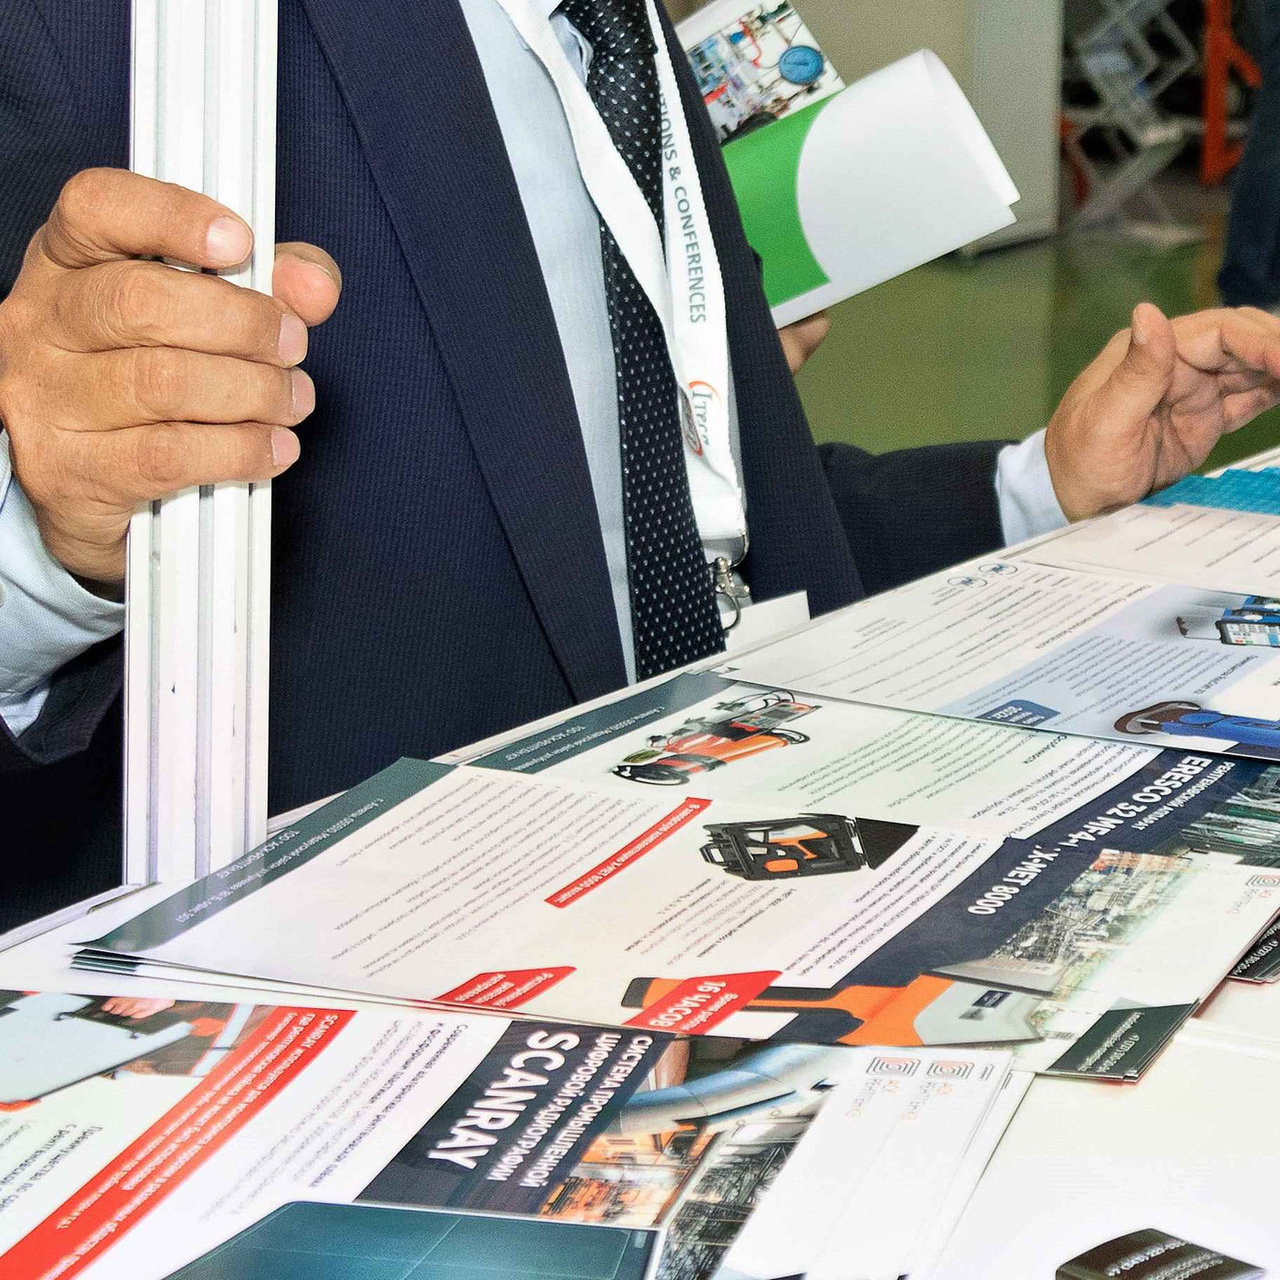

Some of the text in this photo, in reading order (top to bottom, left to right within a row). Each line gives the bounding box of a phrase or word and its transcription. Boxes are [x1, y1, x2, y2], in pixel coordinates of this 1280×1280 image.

[668, 166, 682, 182] &
[673, 185, 707, 324] CONFERENCES
[1128, 755, 1214, 804] ERESCO
[1129, 761, 1237, 830] РЕНТГЕНОВСКИЙ АППАРАТ
[1105, 801, 1148, 819] 32
[964, 849, 1059, 915] X-MET 8000
[296, 1014, 341, 1048] SCANRAY
[646, 980, 729, 1026] 16 ЧАСОВ
[417, 1024, 470, 1069] Современная
[423, 1029, 586, 1169] SCANRAY
[484, 1032, 623, 1181] ЦИФРОВОЙ РАДИОГРАФИИ
[516, 1034, 656, 1187] СИСТЕМА ПРОМЫШЛЕННОЙ
